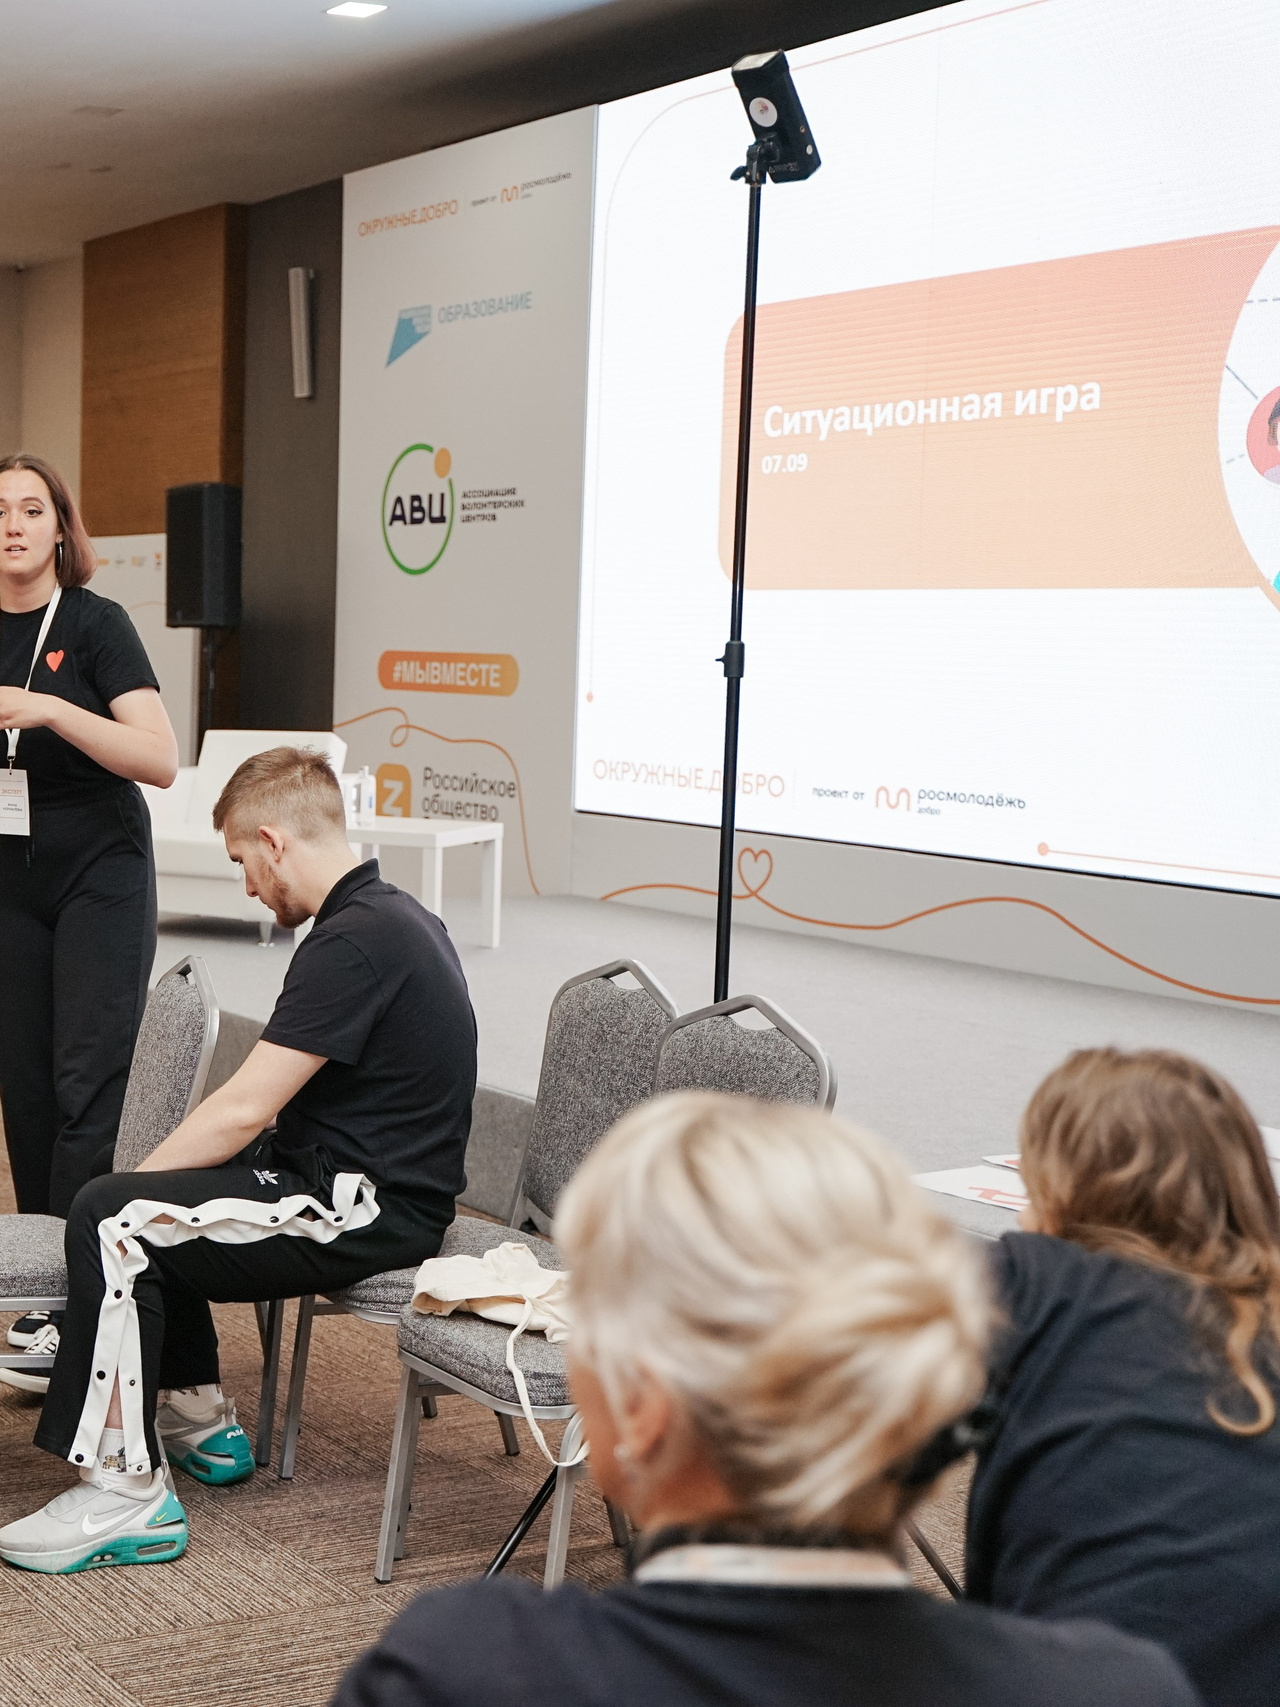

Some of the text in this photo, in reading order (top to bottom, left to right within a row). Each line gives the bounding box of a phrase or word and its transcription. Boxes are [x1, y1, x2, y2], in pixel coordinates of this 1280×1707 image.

[437, 291, 533, 325] ОБРАЗОВАНИЕ
[763, 381, 1102, 441] Ситуационная игра
[761, 453, 809, 475] 07.09
[389, 491, 447, 527] АВЦ
[392, 660, 501, 688] #МЫВМЕСТЕ
[422, 766, 517, 799] Российское
[593, 758, 786, 798] ОКРУЖНЫЕ.ДБРО
[812, 786, 865, 800] проект от
[421, 794, 500, 822] общество
[917, 788, 1027, 810] росмолодёжь
